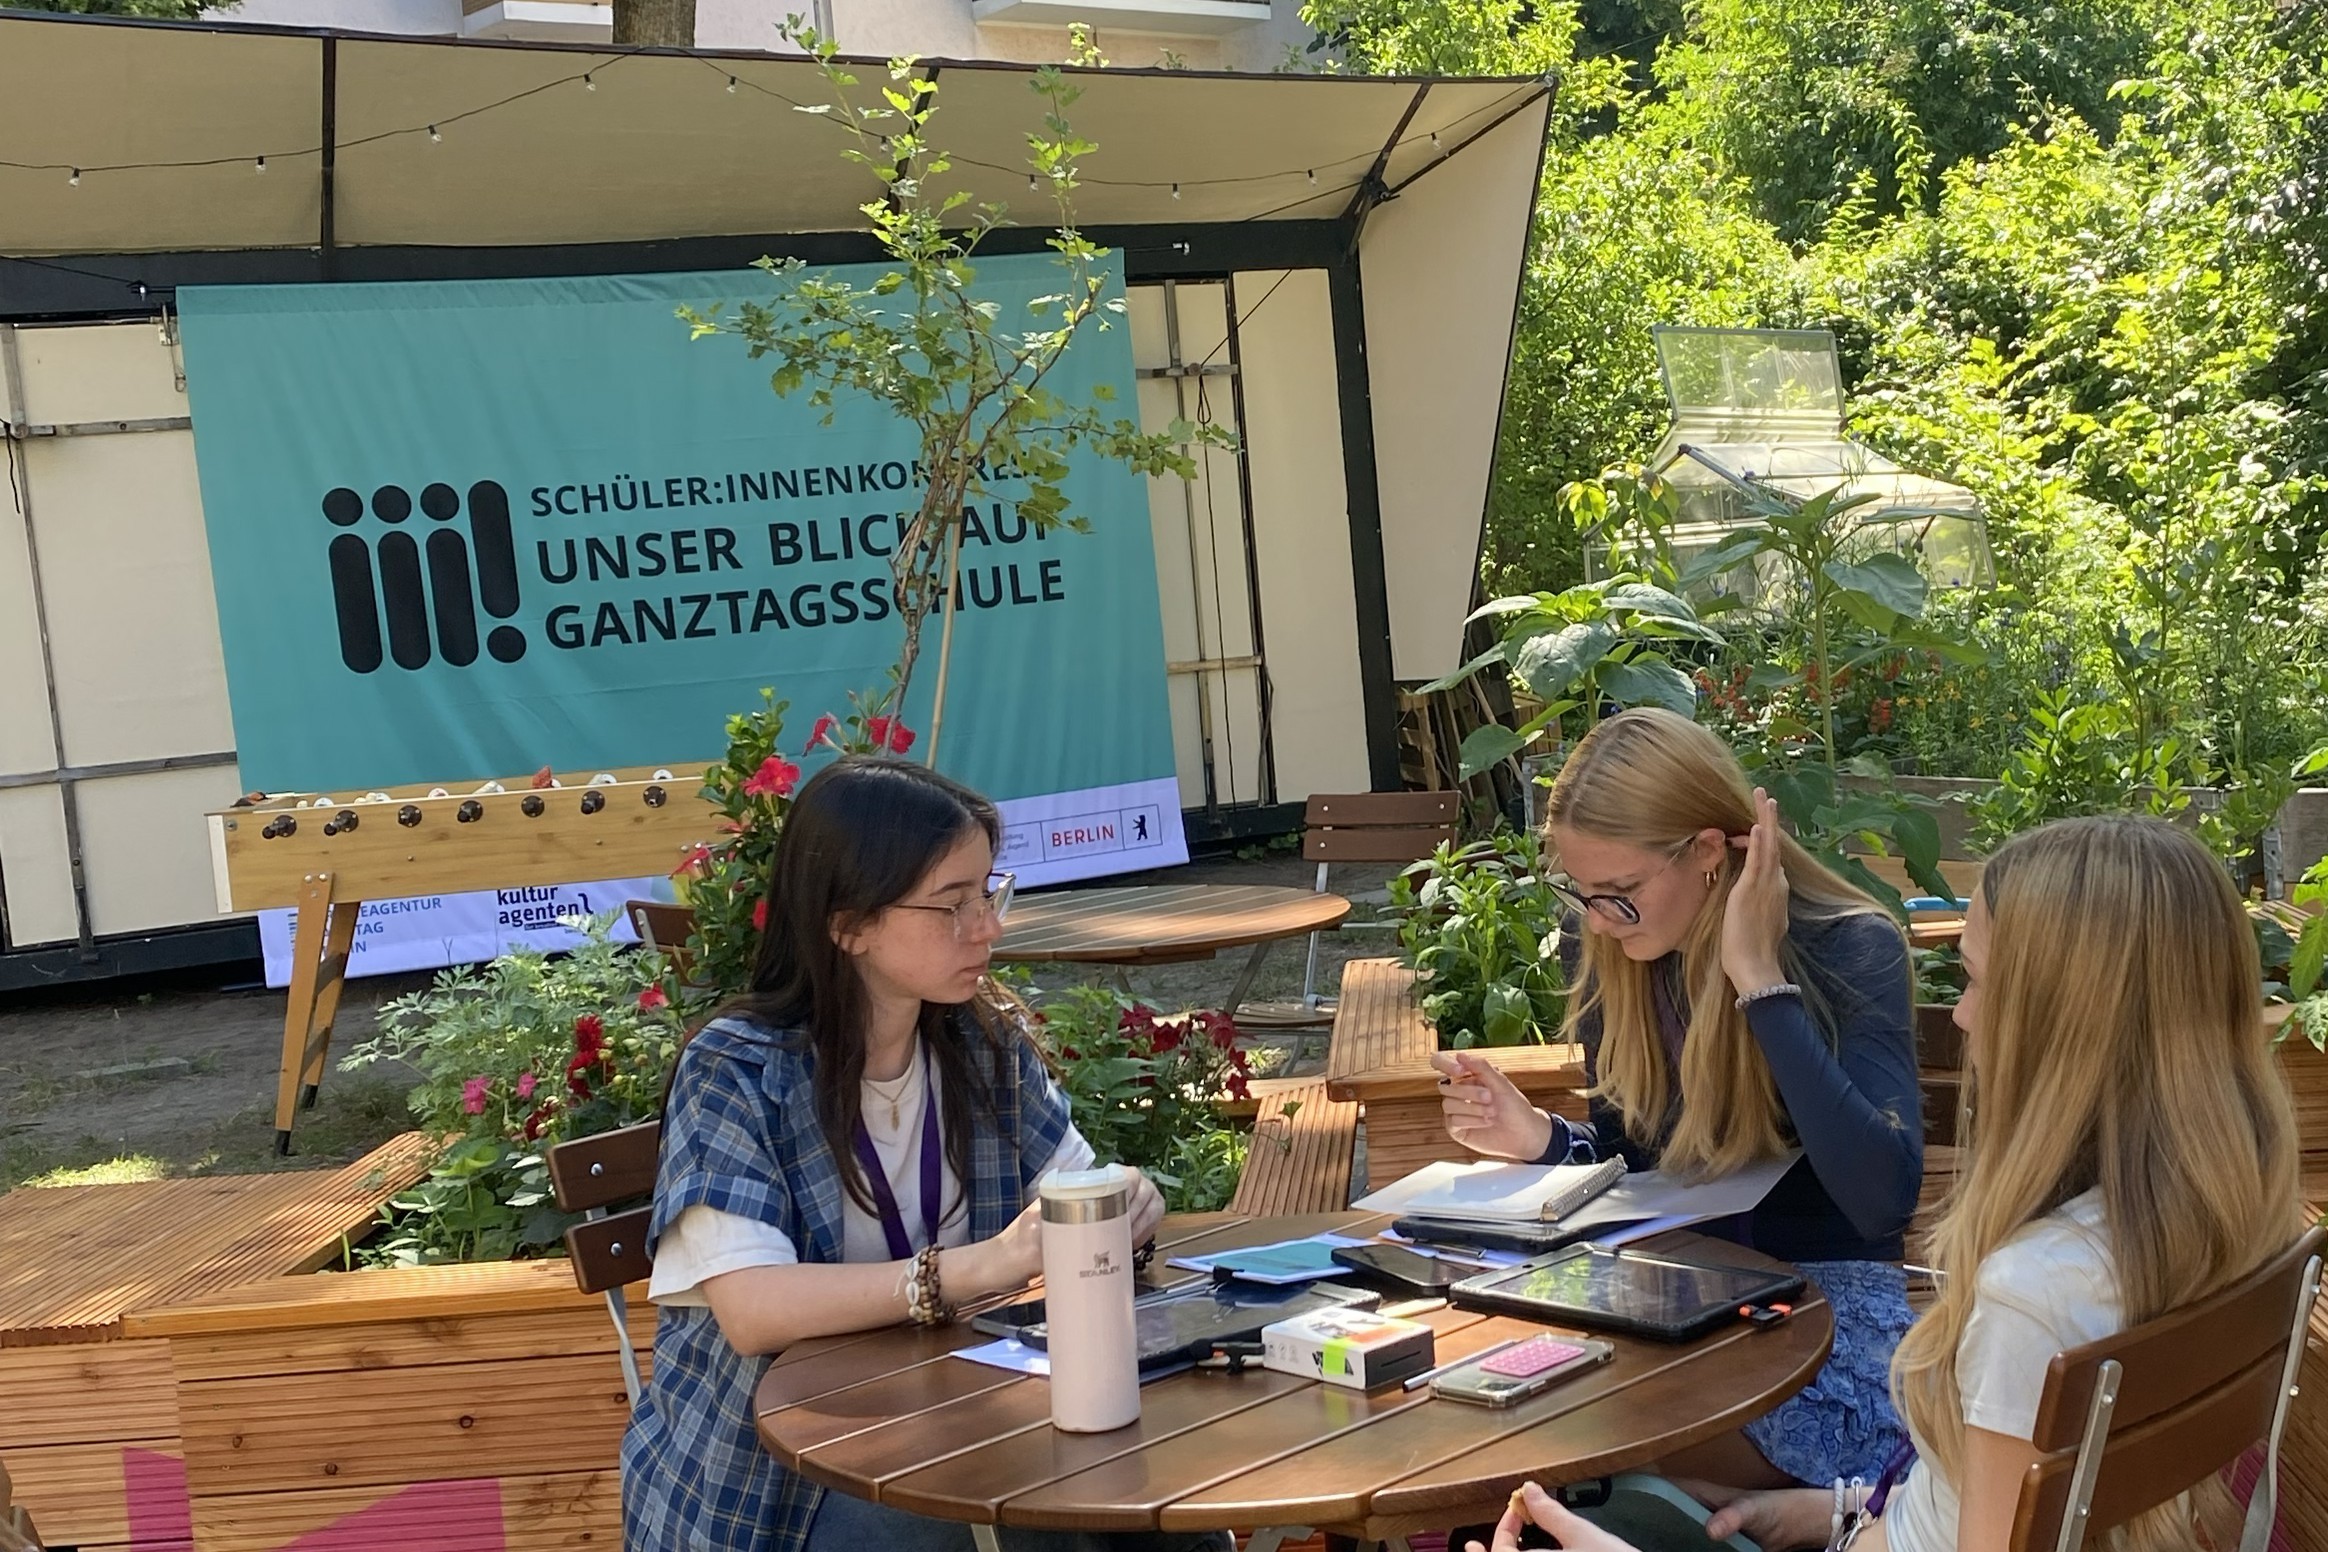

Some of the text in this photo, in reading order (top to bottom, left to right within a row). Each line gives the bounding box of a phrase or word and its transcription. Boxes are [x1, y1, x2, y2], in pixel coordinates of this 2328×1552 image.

[536, 526, 743, 584] UNSER
[957, 501, 1047, 550] AU
[1051, 824, 1115, 848] BERLIN
[359, 897, 442, 917] EAGENTUR
[497, 886, 558, 906] kultur
